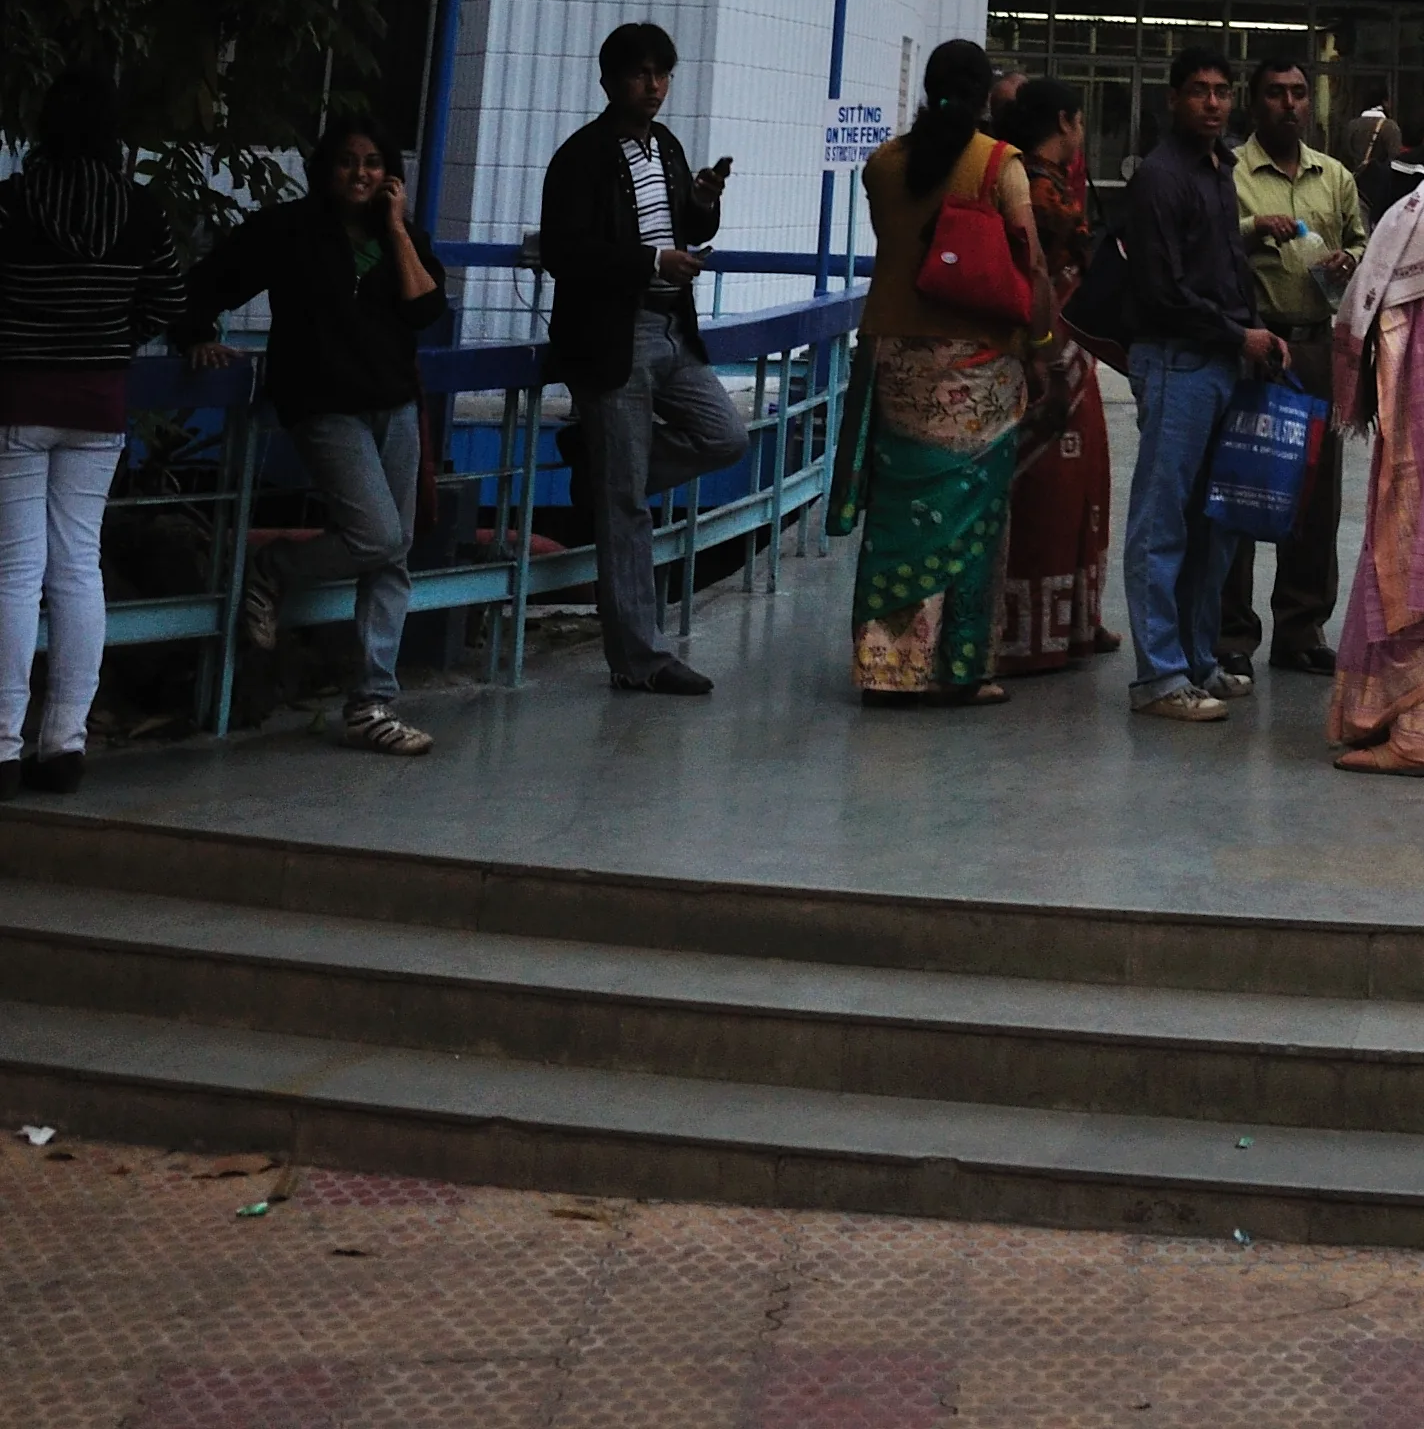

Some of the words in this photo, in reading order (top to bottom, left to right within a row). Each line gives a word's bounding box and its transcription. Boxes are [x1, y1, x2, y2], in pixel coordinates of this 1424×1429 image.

[838, 106, 882, 123] SITTING
[826, 127, 838, 143] ON
[841, 127, 859, 143] THE
[860, 127, 892, 143] FENCE
